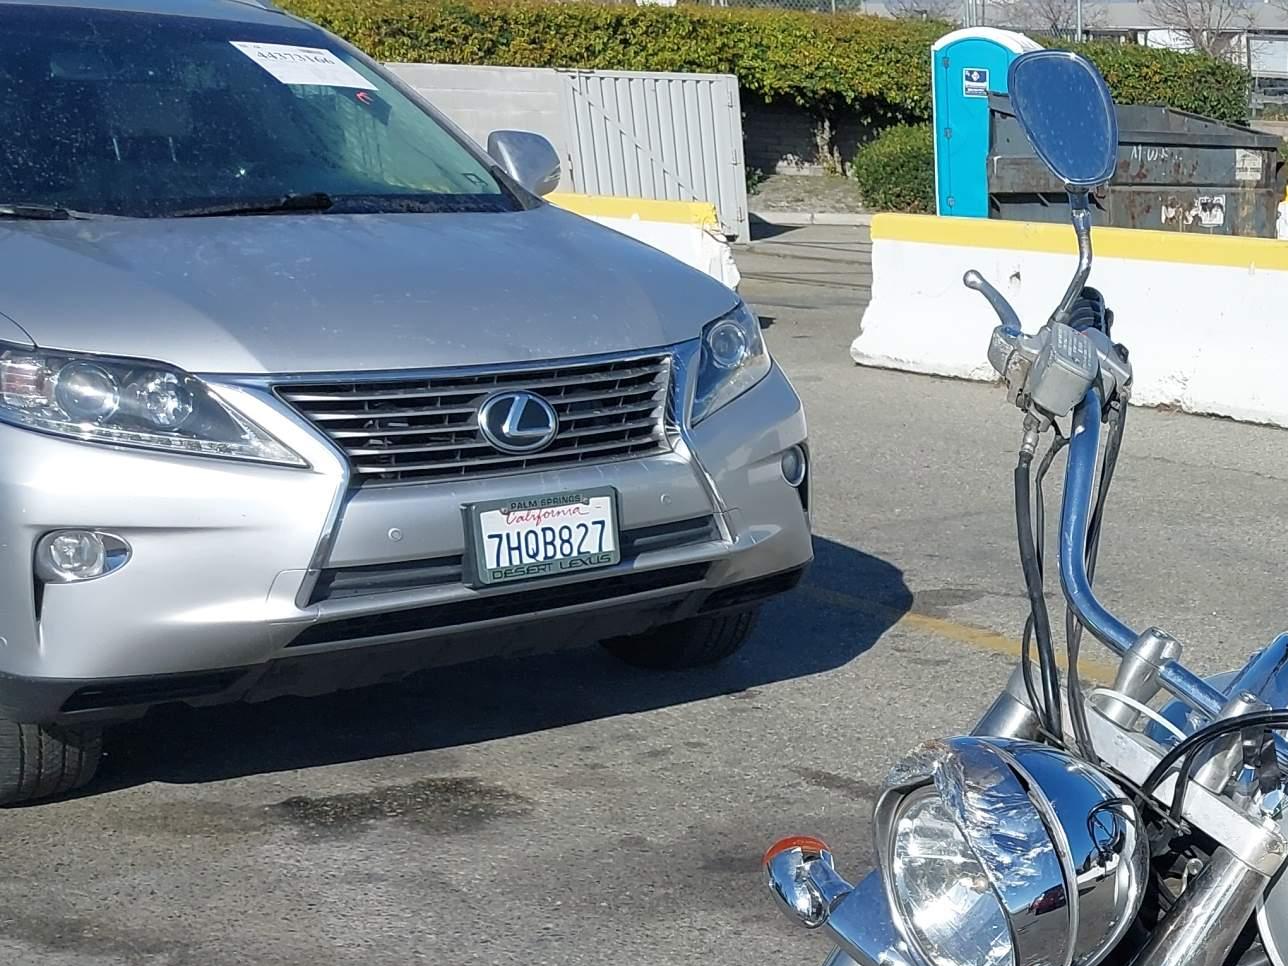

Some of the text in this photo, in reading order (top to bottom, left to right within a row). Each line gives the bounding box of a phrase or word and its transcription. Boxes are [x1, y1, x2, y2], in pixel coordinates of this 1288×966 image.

[510, 494, 581, 510] PALM SPRINGS
[505, 505, 589, 526] California
[487, 519, 606, 567] 7HQB827
[492, 554, 612, 580] DESERT LEXUS
